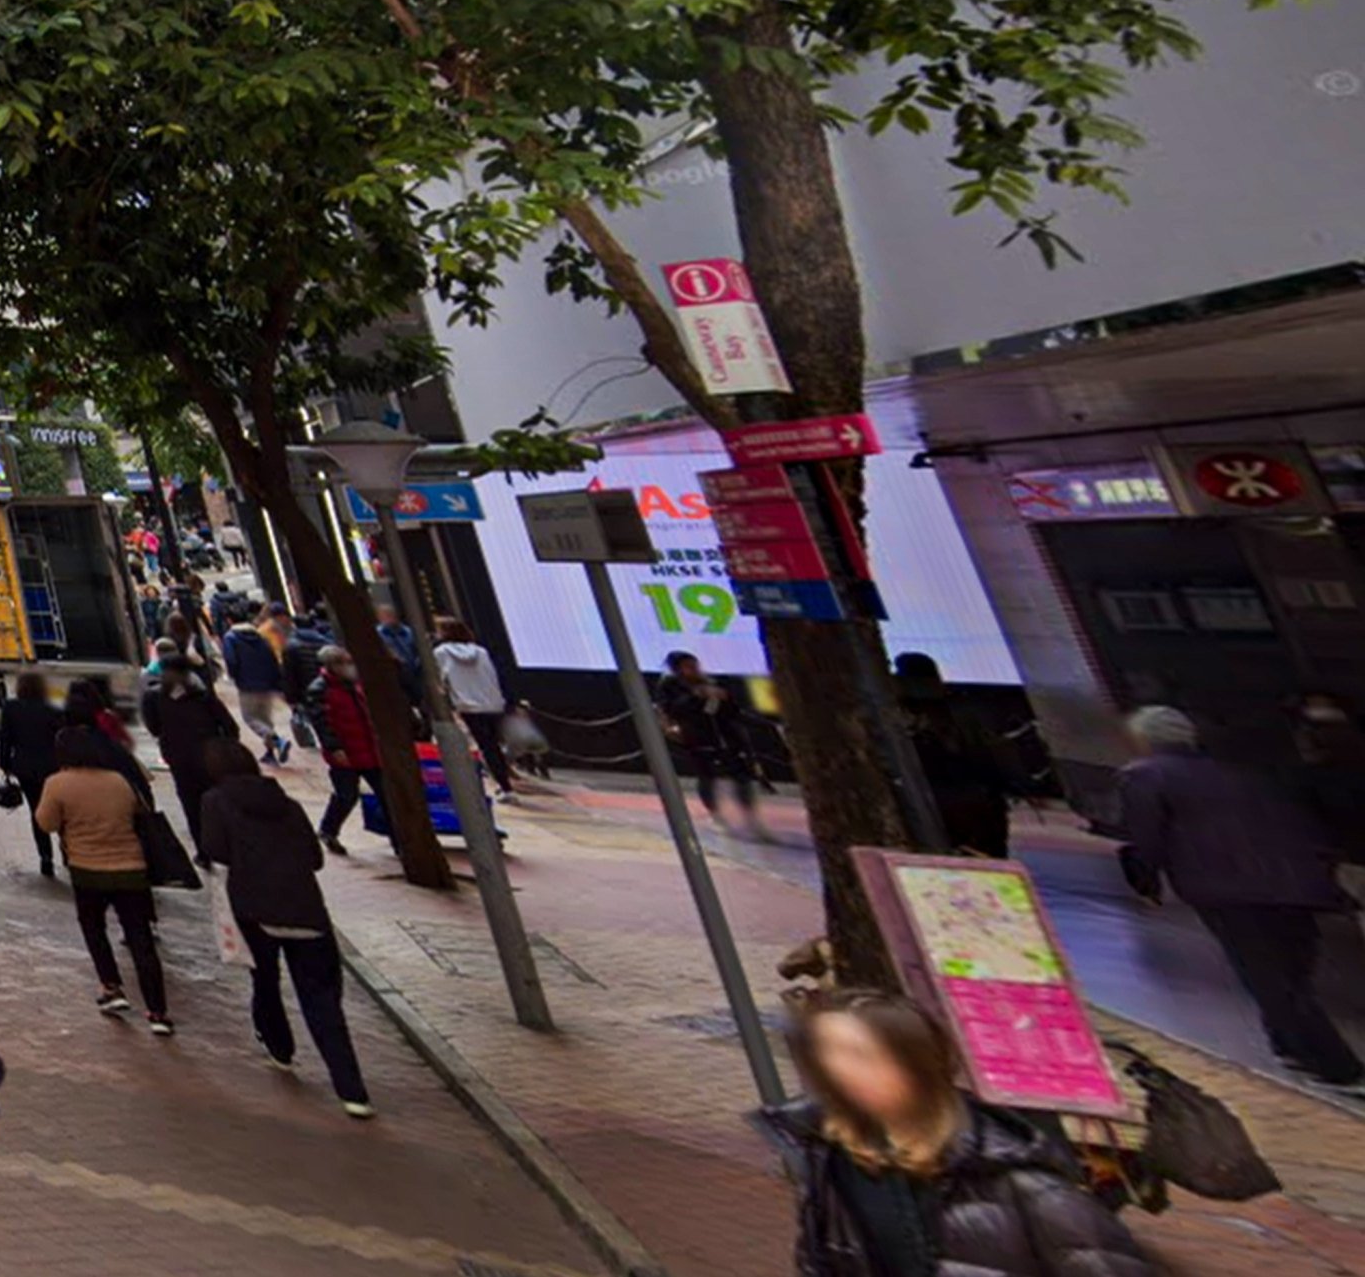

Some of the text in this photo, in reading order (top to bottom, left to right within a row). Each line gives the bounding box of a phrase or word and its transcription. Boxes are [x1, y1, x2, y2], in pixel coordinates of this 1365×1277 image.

[639, 484, 714, 521] As
[651, 565, 704, 578] HKSE
[640, 582, 737, 635] 19
